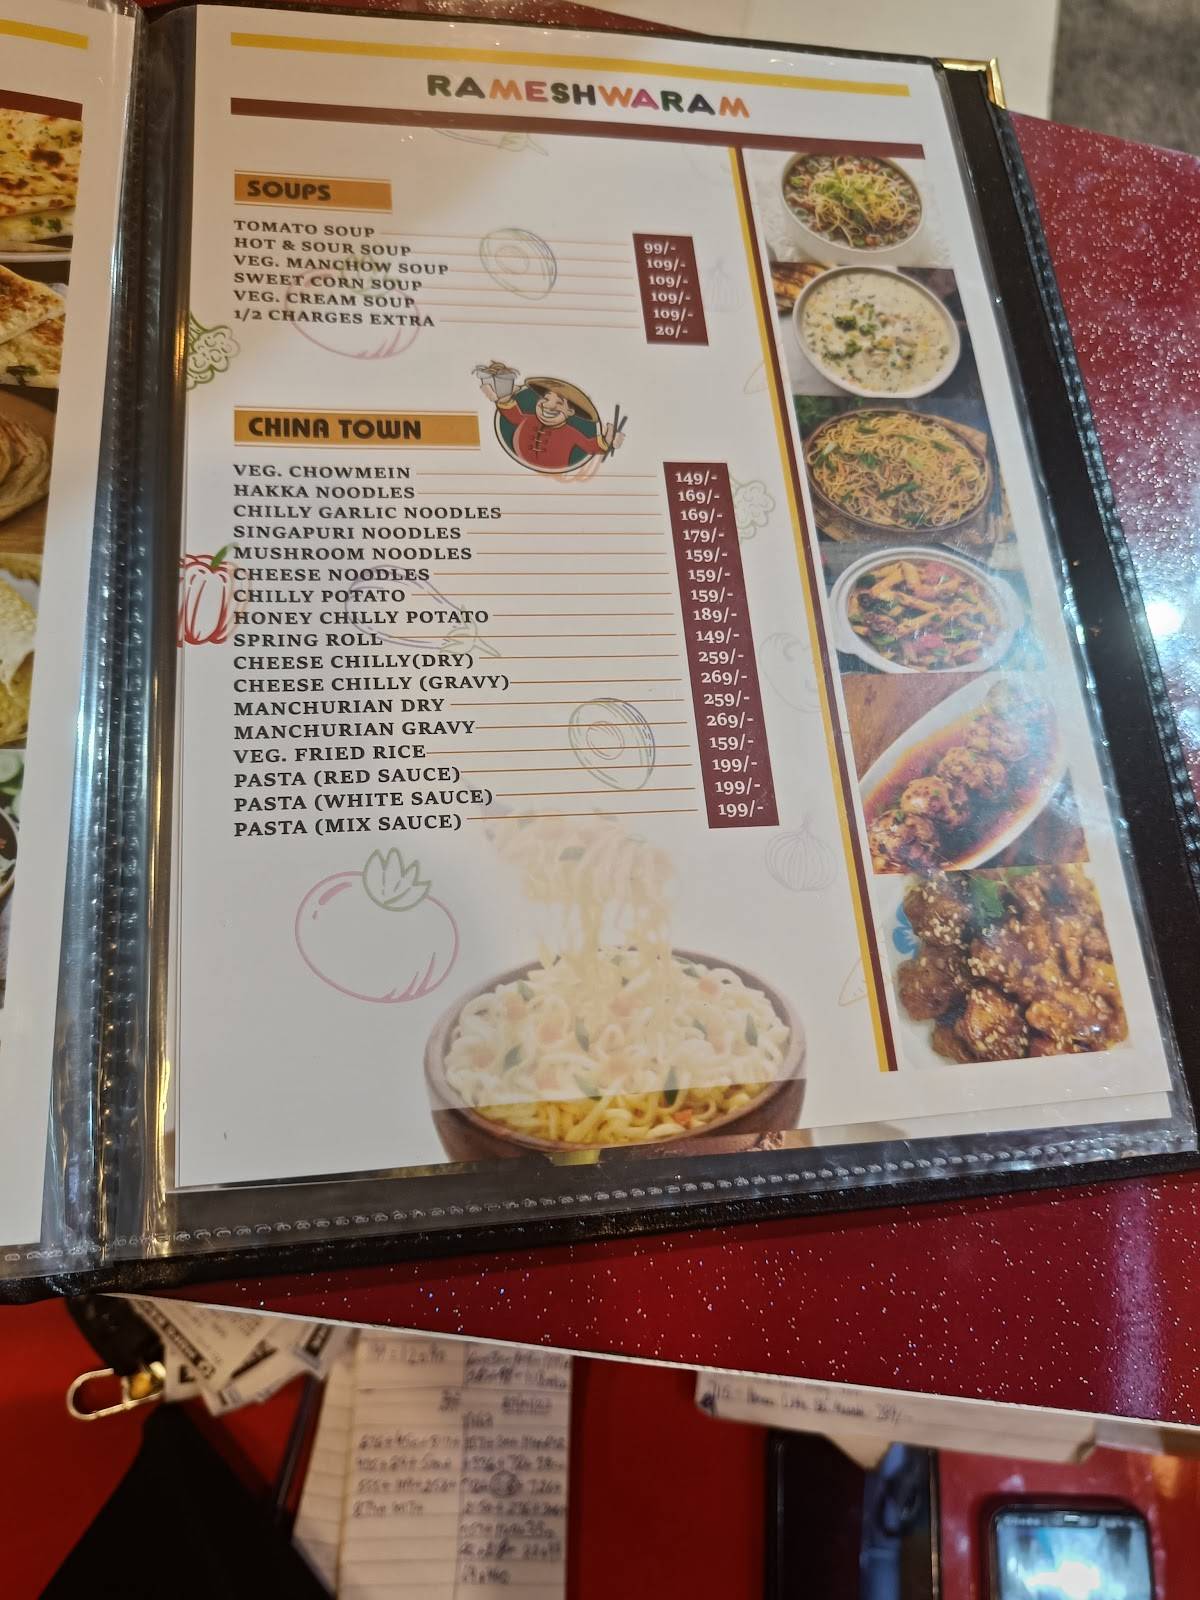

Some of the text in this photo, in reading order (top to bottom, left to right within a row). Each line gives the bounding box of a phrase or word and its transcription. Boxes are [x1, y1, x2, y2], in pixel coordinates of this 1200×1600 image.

[426, 74, 751, 119] RAMESHWARAM
[247, 181, 331, 200] SOUPS
[234, 220, 375, 238] TOMATO SOUP
[234, 238, 411, 257] HOT & SOUR SOUP
[643, 241, 676, 255] 99/-
[234, 255, 449, 275] VEG. MANCHOW SOUP
[646, 258, 686, 272] 109/-
[234, 273, 422, 291] SWEET CORN SOUP
[649, 275, 688, 288] 109/-
[234, 290, 415, 308] VEG. CREAM SOUP
[651, 291, 691, 305] 109/-
[234, 309, 435, 327] 1/2 CHARGES EXTRA
[654, 308, 693, 322] 109/-
[655, 325, 688, 339] 20/-
[249, 417, 421, 440] CHINA TOWN
[233, 464, 410, 479] VEG. CHOWMEIN
[675, 470, 718, 486] 149/-
[233, 485, 415, 499] HAKKA NOODLES
[678, 489, 720, 504] 169/-
[233, 505, 502, 519] CHILLY GARLIC NOODLES
[680, 508, 723, 524] 169/-
[233, 526, 461, 540] SINGAPURI NOODLES
[683, 528, 725, 543] 179/-
[233, 546, 472, 561] MUSHROOM NOODLES
[685, 547, 728, 563] 159/-
[233, 568, 430, 581] CHEESE NOODLES
[688, 567, 731, 583] 159/-
[233, 589, 406, 603] CHILLY POTATO
[691, 587, 733, 603] 159/-
[233, 610, 489, 625] HONEY CHILLY POTATO
[693, 607, 737, 624] 189/-
[233, 633, 383, 647] SPRING ROLL
[695, 627, 740, 644] 149/-
[233, 656, 323, 670] CHEESE
[698, 648, 744, 665] 259/-
[233, 675, 509, 692] CHEESE CHILLY (GRAVY)
[701, 669, 748, 686] 269/-
[233, 698, 445, 716] MANCHURIAN DRY
[703, 690, 750, 707] 259/-
[706, 712, 754, 729] 269/-
[233, 720, 475, 740] MANCHURIAN GRAVY
[709, 734, 754, 751] 159/-
[233, 744, 426, 763] VEG. FRIED RICE
[712, 755, 758, 773] 199/-
[234, 766, 460, 787] PASTA (RED SAUCE)
[715, 777, 760, 795] 199/-
[234, 789, 493, 812] PASTA (WHITE SAUCE)
[718, 799, 764, 818] 199/-
[234, 814, 462, 837] PASTA (MIX SAUCE)
